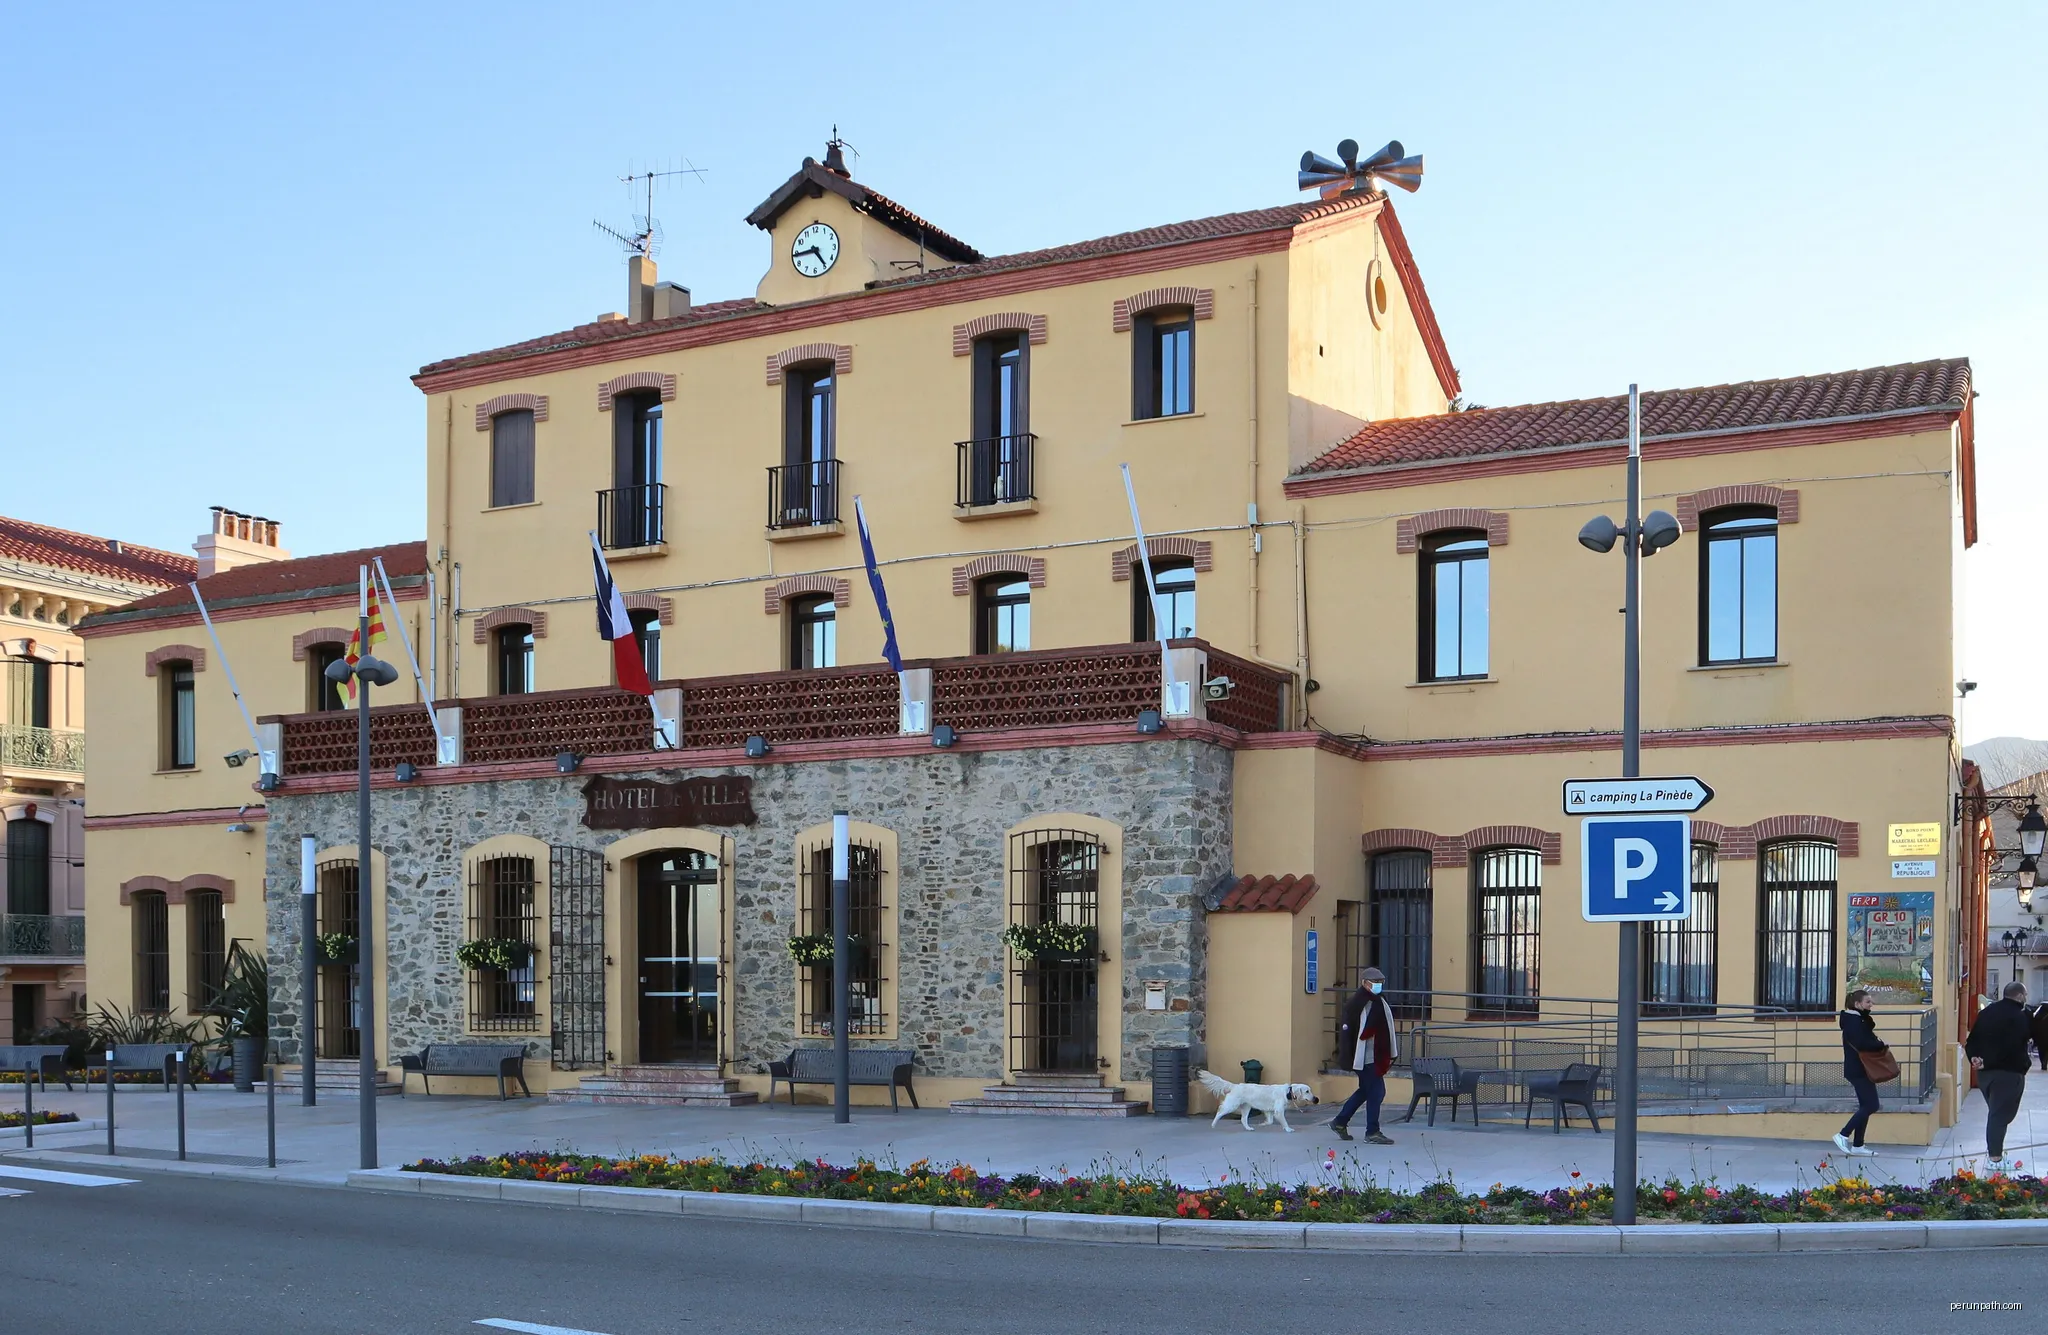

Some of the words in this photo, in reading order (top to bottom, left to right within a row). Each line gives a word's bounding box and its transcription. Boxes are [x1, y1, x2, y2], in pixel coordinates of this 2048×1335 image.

[689, 785, 746, 806] VILLE
[1590, 790, 1637, 804] camping
[1640, 791, 1653, 801] La
[1655, 790, 1693, 801] Pinède
[1614, 837, 1658, 899] P
[1873, 912, 1889, 923] GR
[1894, 911, 1907, 922] 10
[1872, 927, 1908, 936] BANYULS
